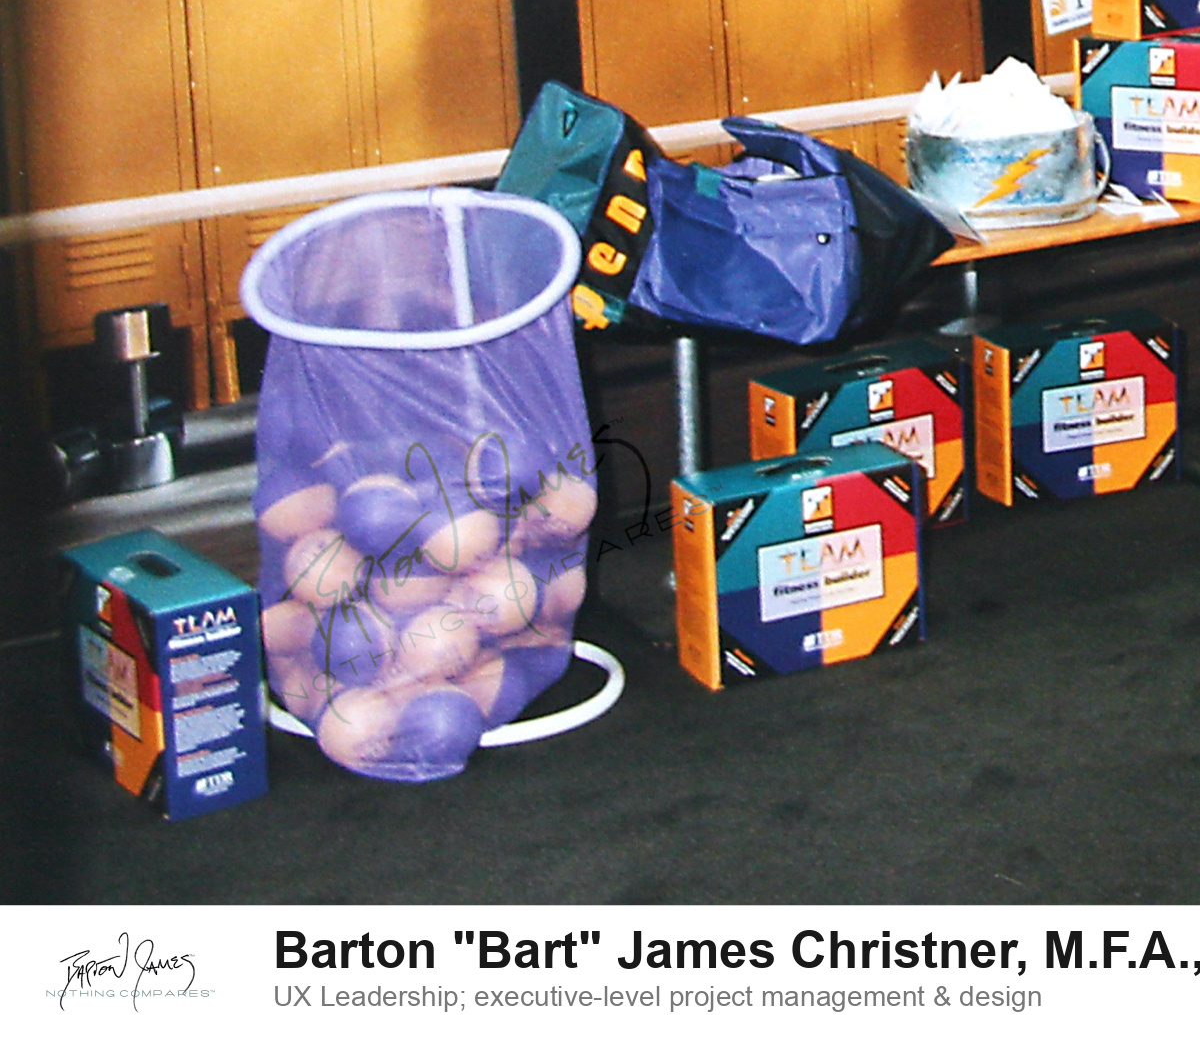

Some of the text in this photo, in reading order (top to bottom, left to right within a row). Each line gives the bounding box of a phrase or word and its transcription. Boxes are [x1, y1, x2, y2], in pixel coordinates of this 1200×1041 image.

[1123, 122, 1162, 133] fitness
[773, 568, 871, 597] fitness builder
